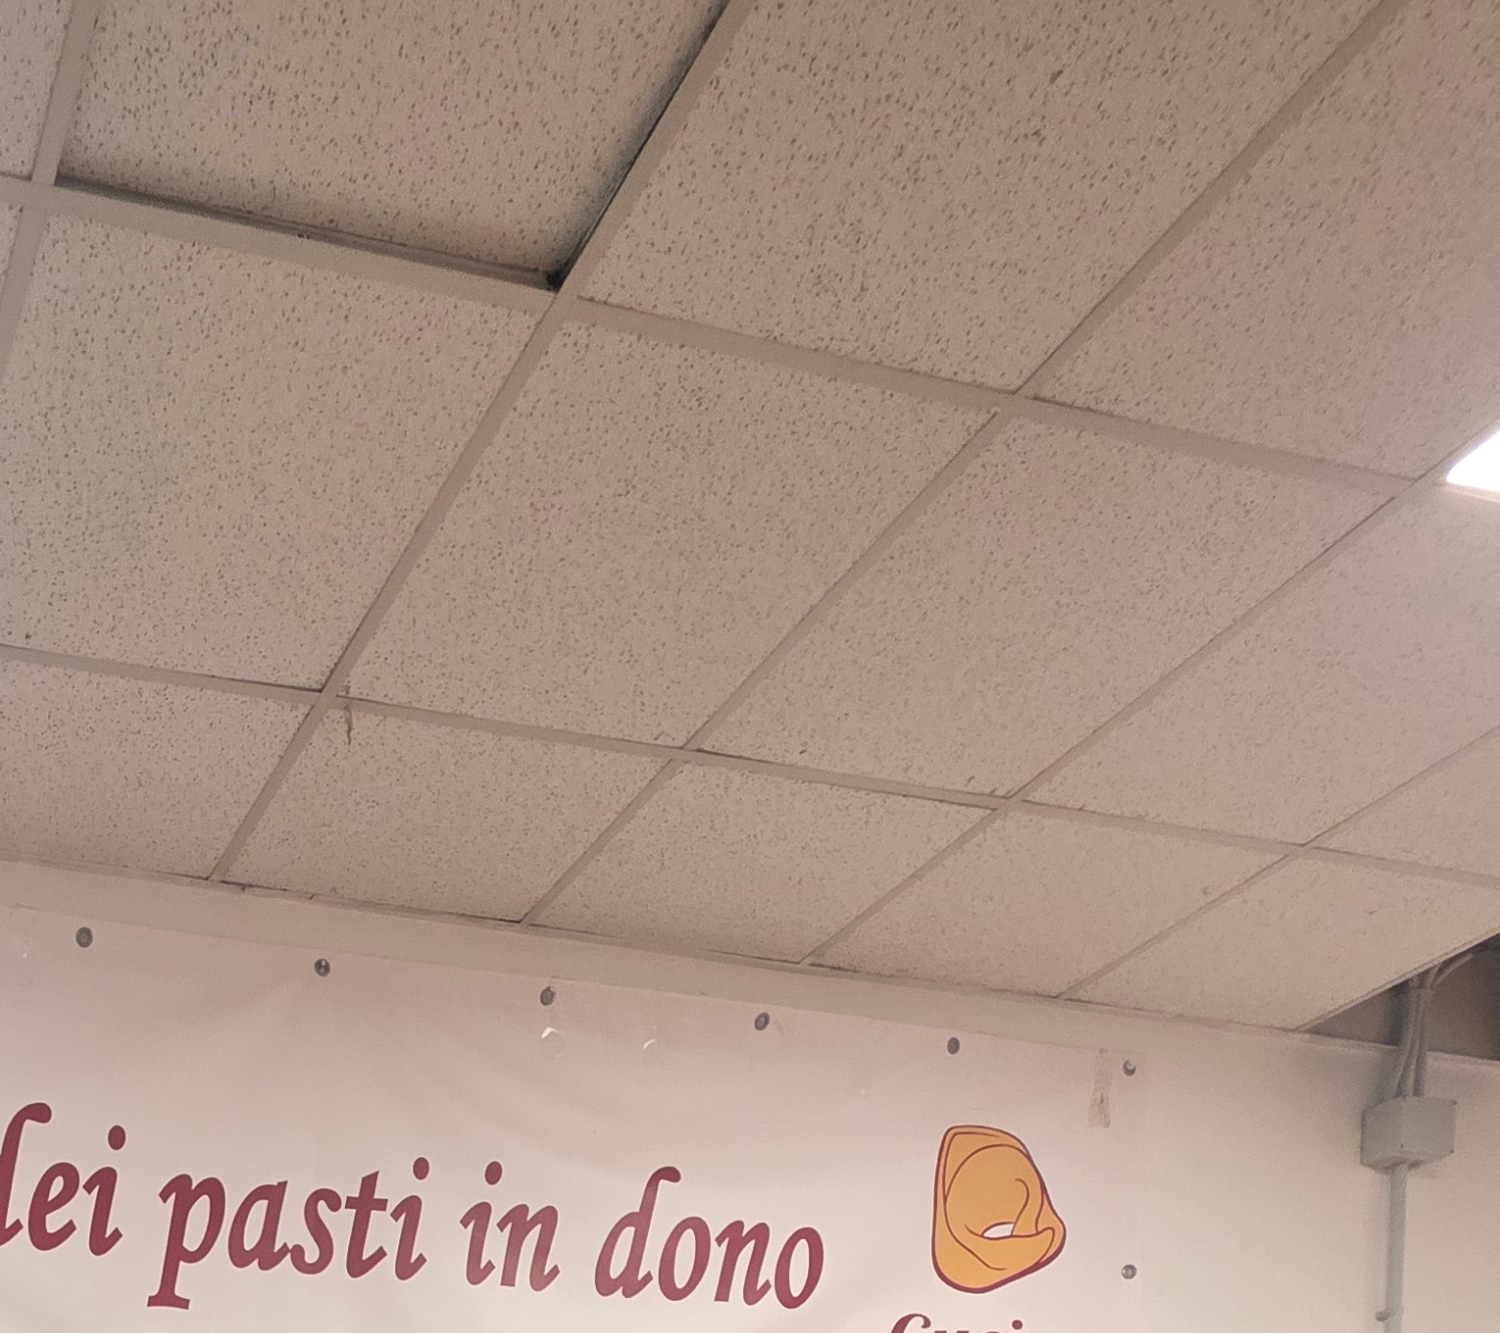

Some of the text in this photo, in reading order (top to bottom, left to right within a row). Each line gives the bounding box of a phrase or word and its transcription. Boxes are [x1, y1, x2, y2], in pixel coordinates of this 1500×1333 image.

[147, 1156, 429, 1311] pasti
[459, 1161, 561, 1292] in
[594, 1165, 825, 1310] dono
